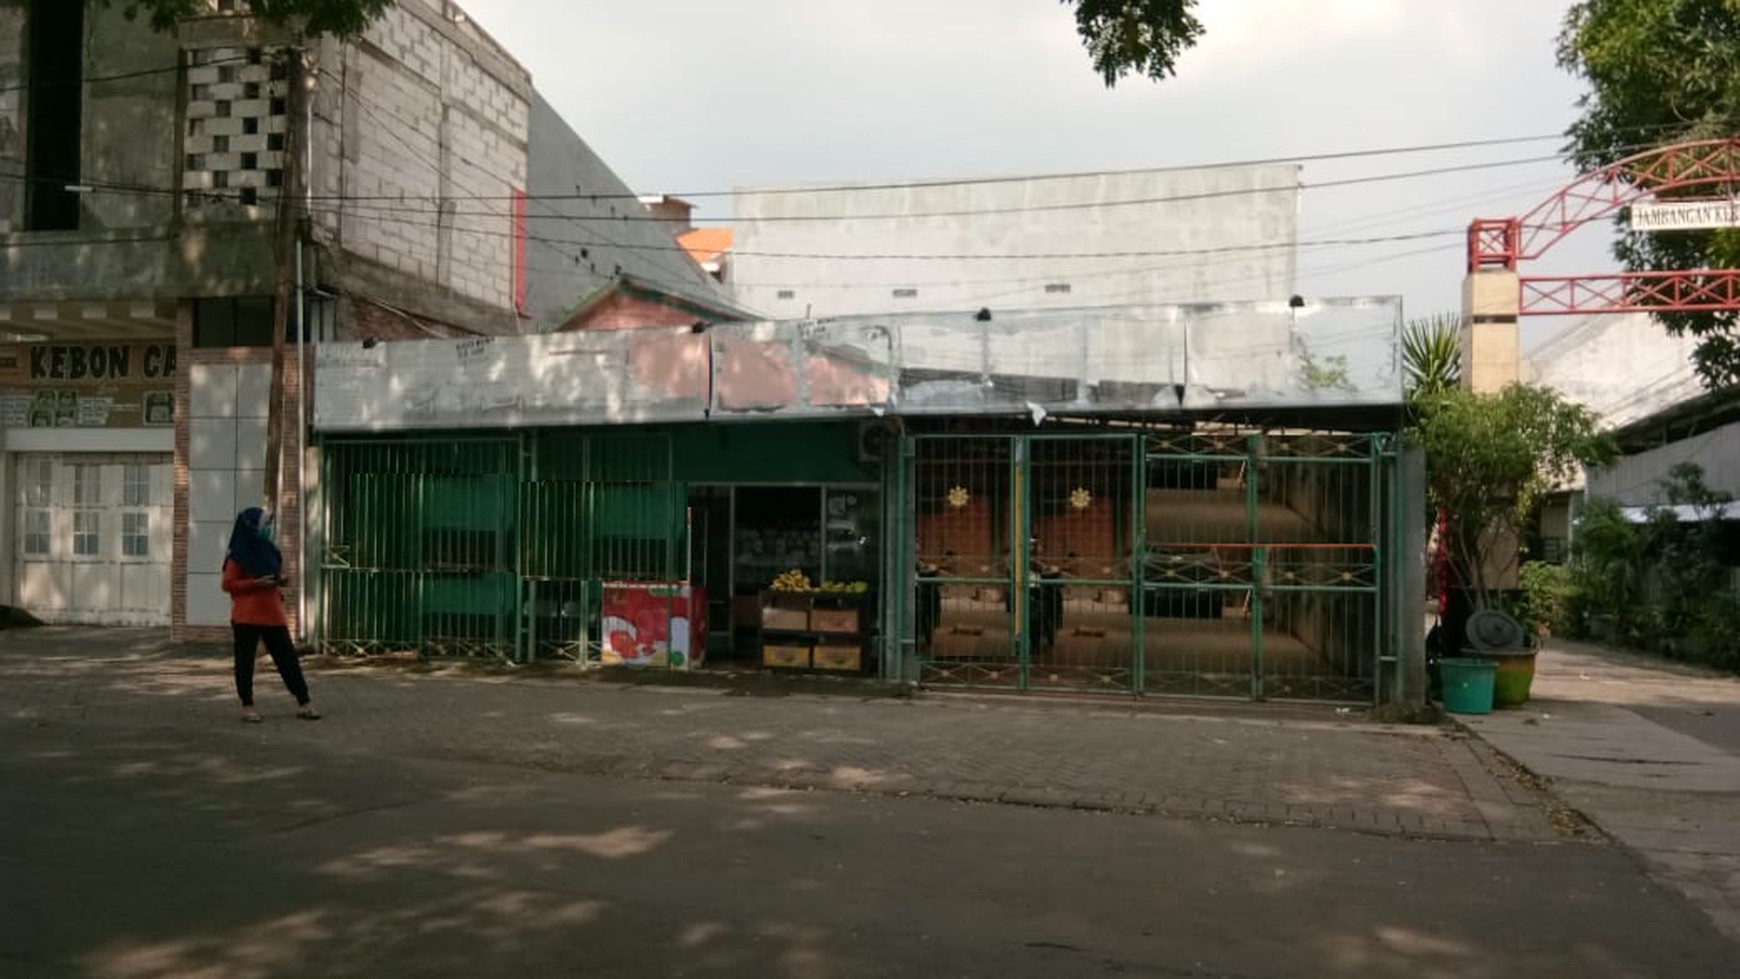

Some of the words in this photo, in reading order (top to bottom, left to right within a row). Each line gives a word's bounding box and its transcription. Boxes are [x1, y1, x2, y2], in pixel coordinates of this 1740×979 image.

[1636, 206, 1711, 226] JAMBANGAN
[30, 345, 130, 379] KEBON
[143, 345, 176, 378] CA
